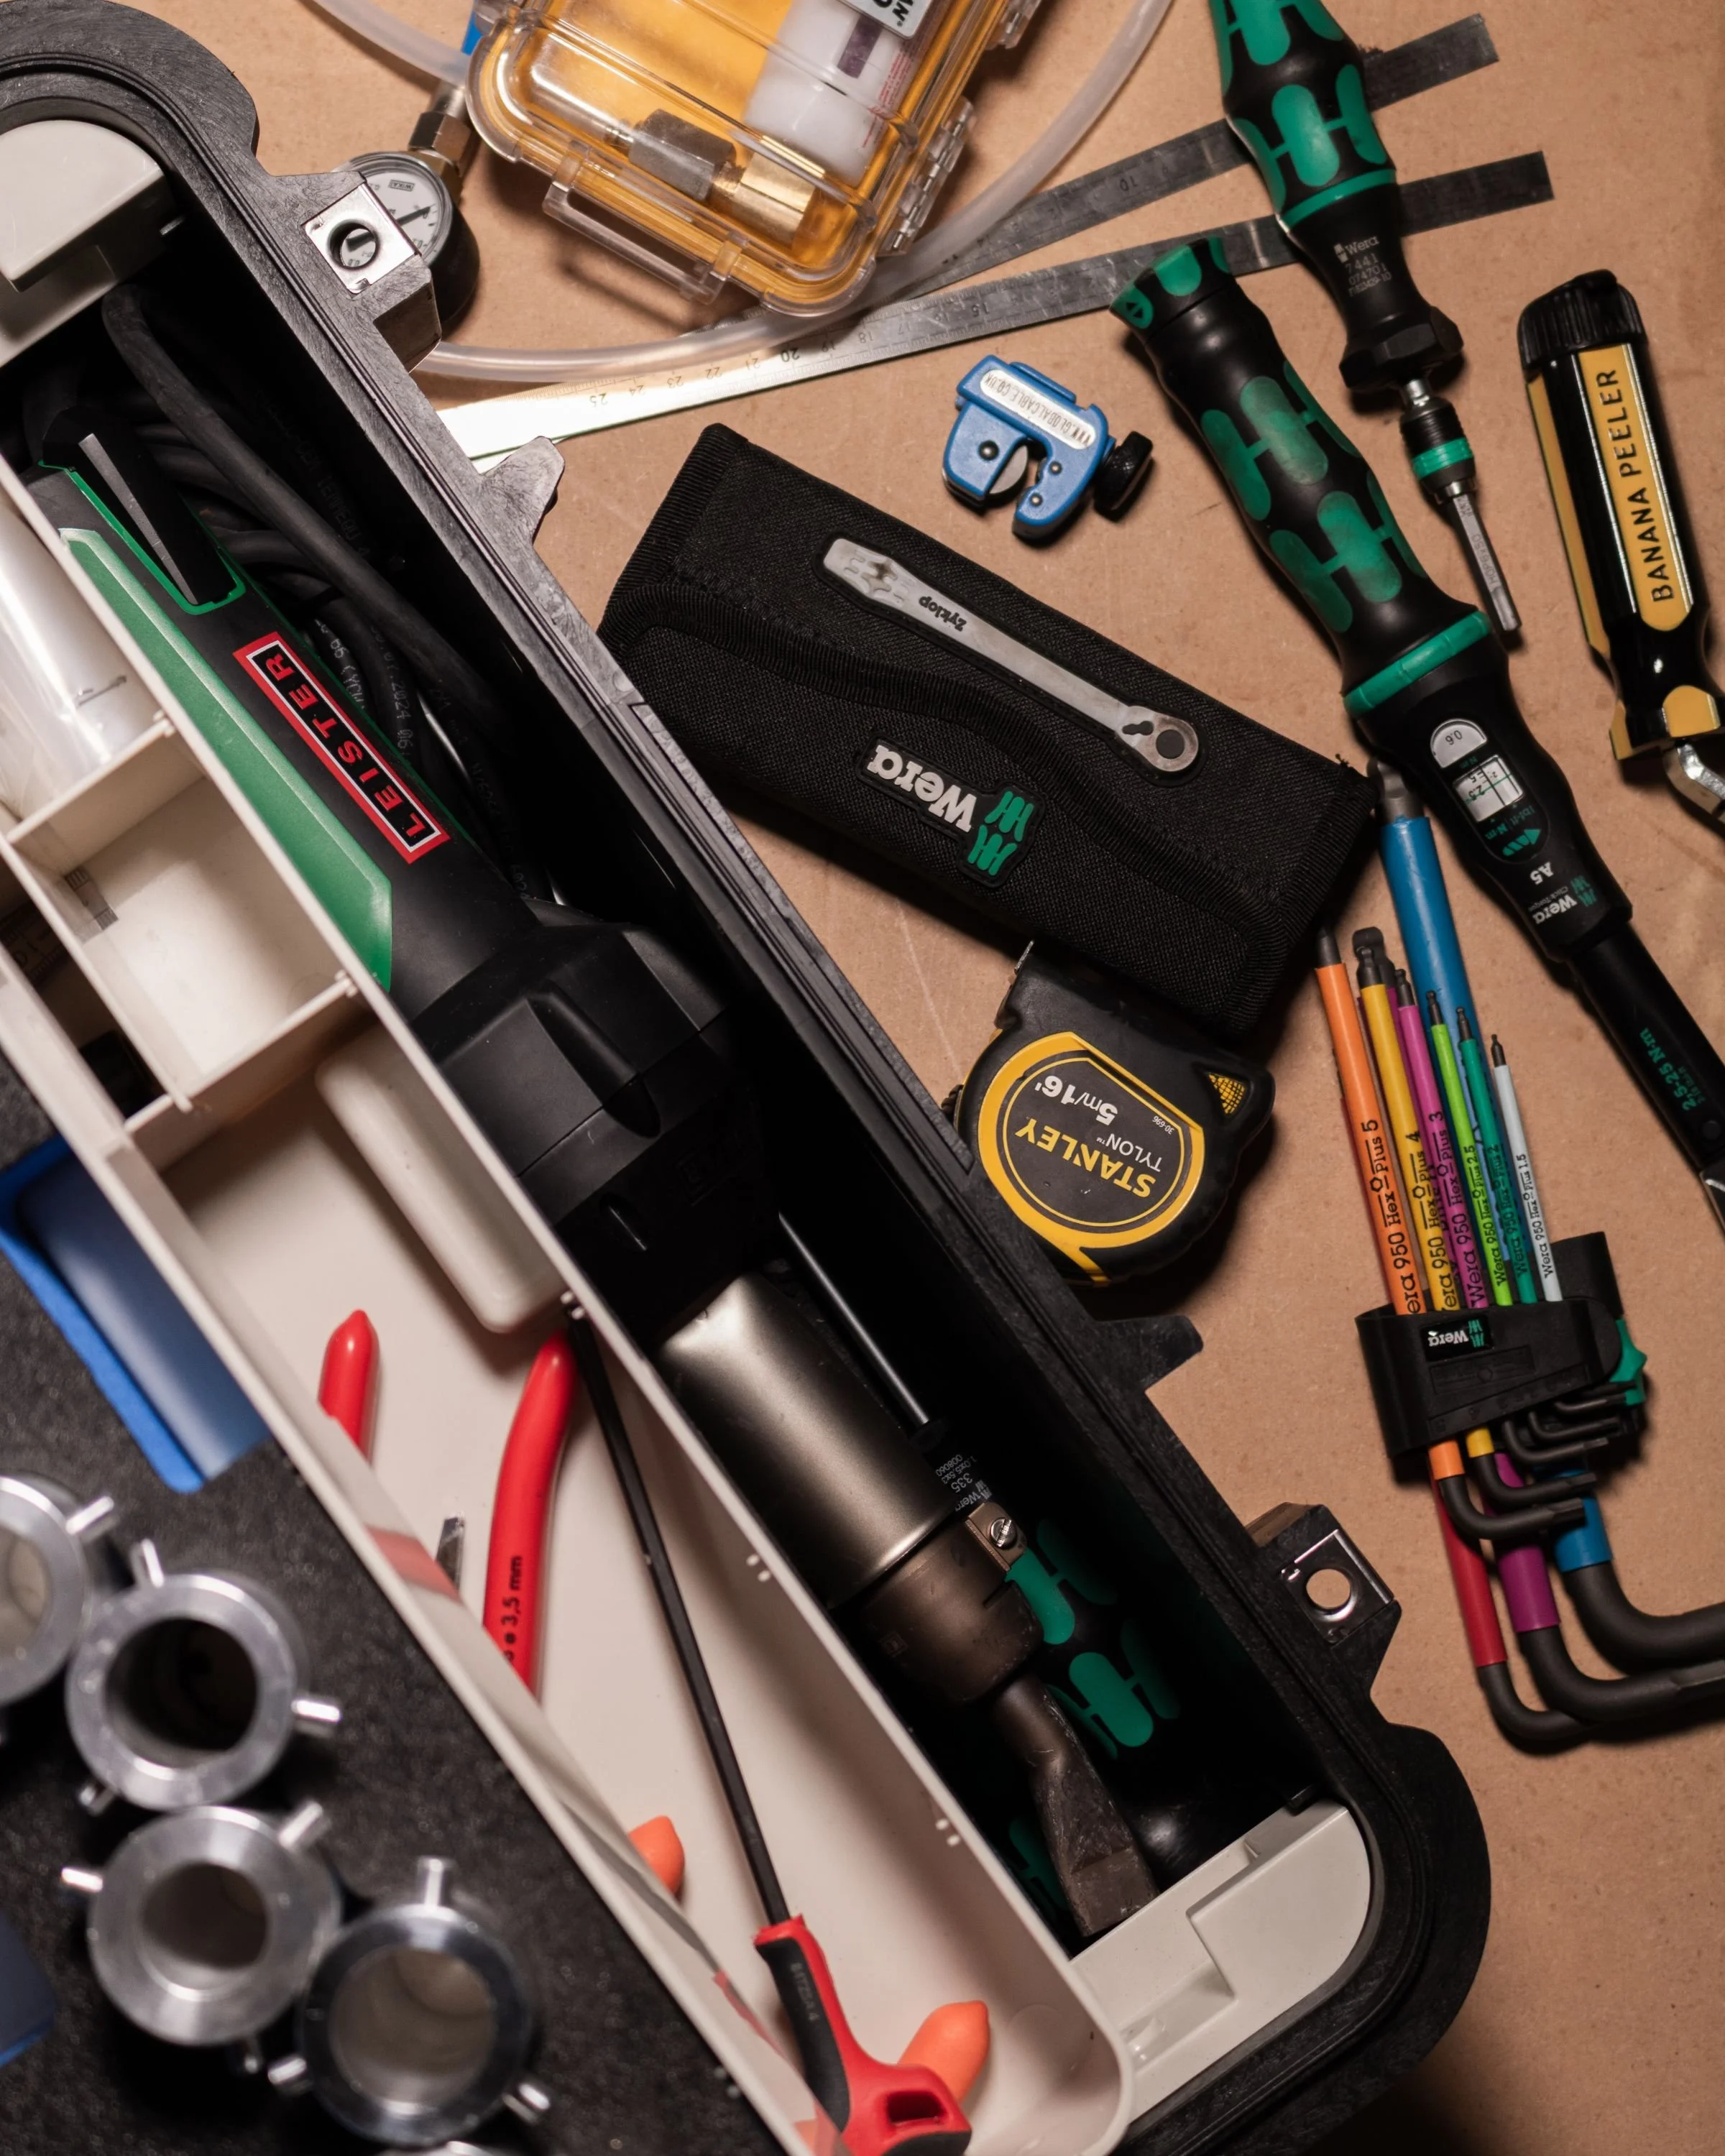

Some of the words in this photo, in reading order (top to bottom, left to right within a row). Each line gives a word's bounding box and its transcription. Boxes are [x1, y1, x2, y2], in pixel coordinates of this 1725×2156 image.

[1120, 175, 1138, 193] 10
[1345, 236, 1380, 255] Wera
[1345, 252, 1379, 275] 7441
[972, 302, 989, 318] 15
[858, 331, 873, 344] 18
[897, 321, 911, 336] 17
[779, 347, 800, 364] 20
[821, 339, 835, 353] 19
[704, 366, 722, 379] 22
[745, 356, 760, 371] 21
[629, 384, 644, 397] 24
[666, 375, 684, 389] 23
[589, 392, 608, 407] 25
[1595, 369, 1642, 478] PEELER
[1627, 487, 1674, 602] BANANA
[919, 595, 967, 632] Zyklop
[264, 653, 426, 837] LEISTER
[1445, 729, 1463, 746] 0.6
[867, 744, 978, 834] Wera
[1468, 785, 1486, 801] 2.5
[1530, 861, 1554, 885] A5
[1532, 894, 1578, 925] Wera
[1034, 1074, 1118, 1126] 5m/16'
[1151, 1115, 1175, 1135] 30-696
[1361, 1119, 1379, 1133] 5
[1429, 1111, 1443, 1123] 3
[1405, 1130, 1421, 1142] 4
[1014, 1118, 1156, 1198] STANLEY
[1463, 1145, 1477, 1164] 2.5
[1487, 1144, 1498, 1153] 2
[1516, 1153, 1527, 1169] 1.5
[1451, 1212, 1472, 1245] 950
[1504, 1210, 1519, 1234] 950
[1532, 1220, 1545, 1241] 950
[1483, 1222, 1497, 1244] 950
[1387, 1232, 1411, 1270] 950
[1427, 1236, 1448, 1269] 950
[1511, 1237, 1528, 1278] Wera
[1540, 1243, 1554, 1279] Wera
[1491, 1247, 1506, 1286] Wera
[1465, 1249, 1486, 1307] Wera
[1401, 1272, 1422, 1314] era
[1439, 1272, 1458, 1312] era
[1427, 1330, 1469, 1347] Wera
[950, 1473, 972, 1493] 335
[510, 1555, 523, 1590] mm
